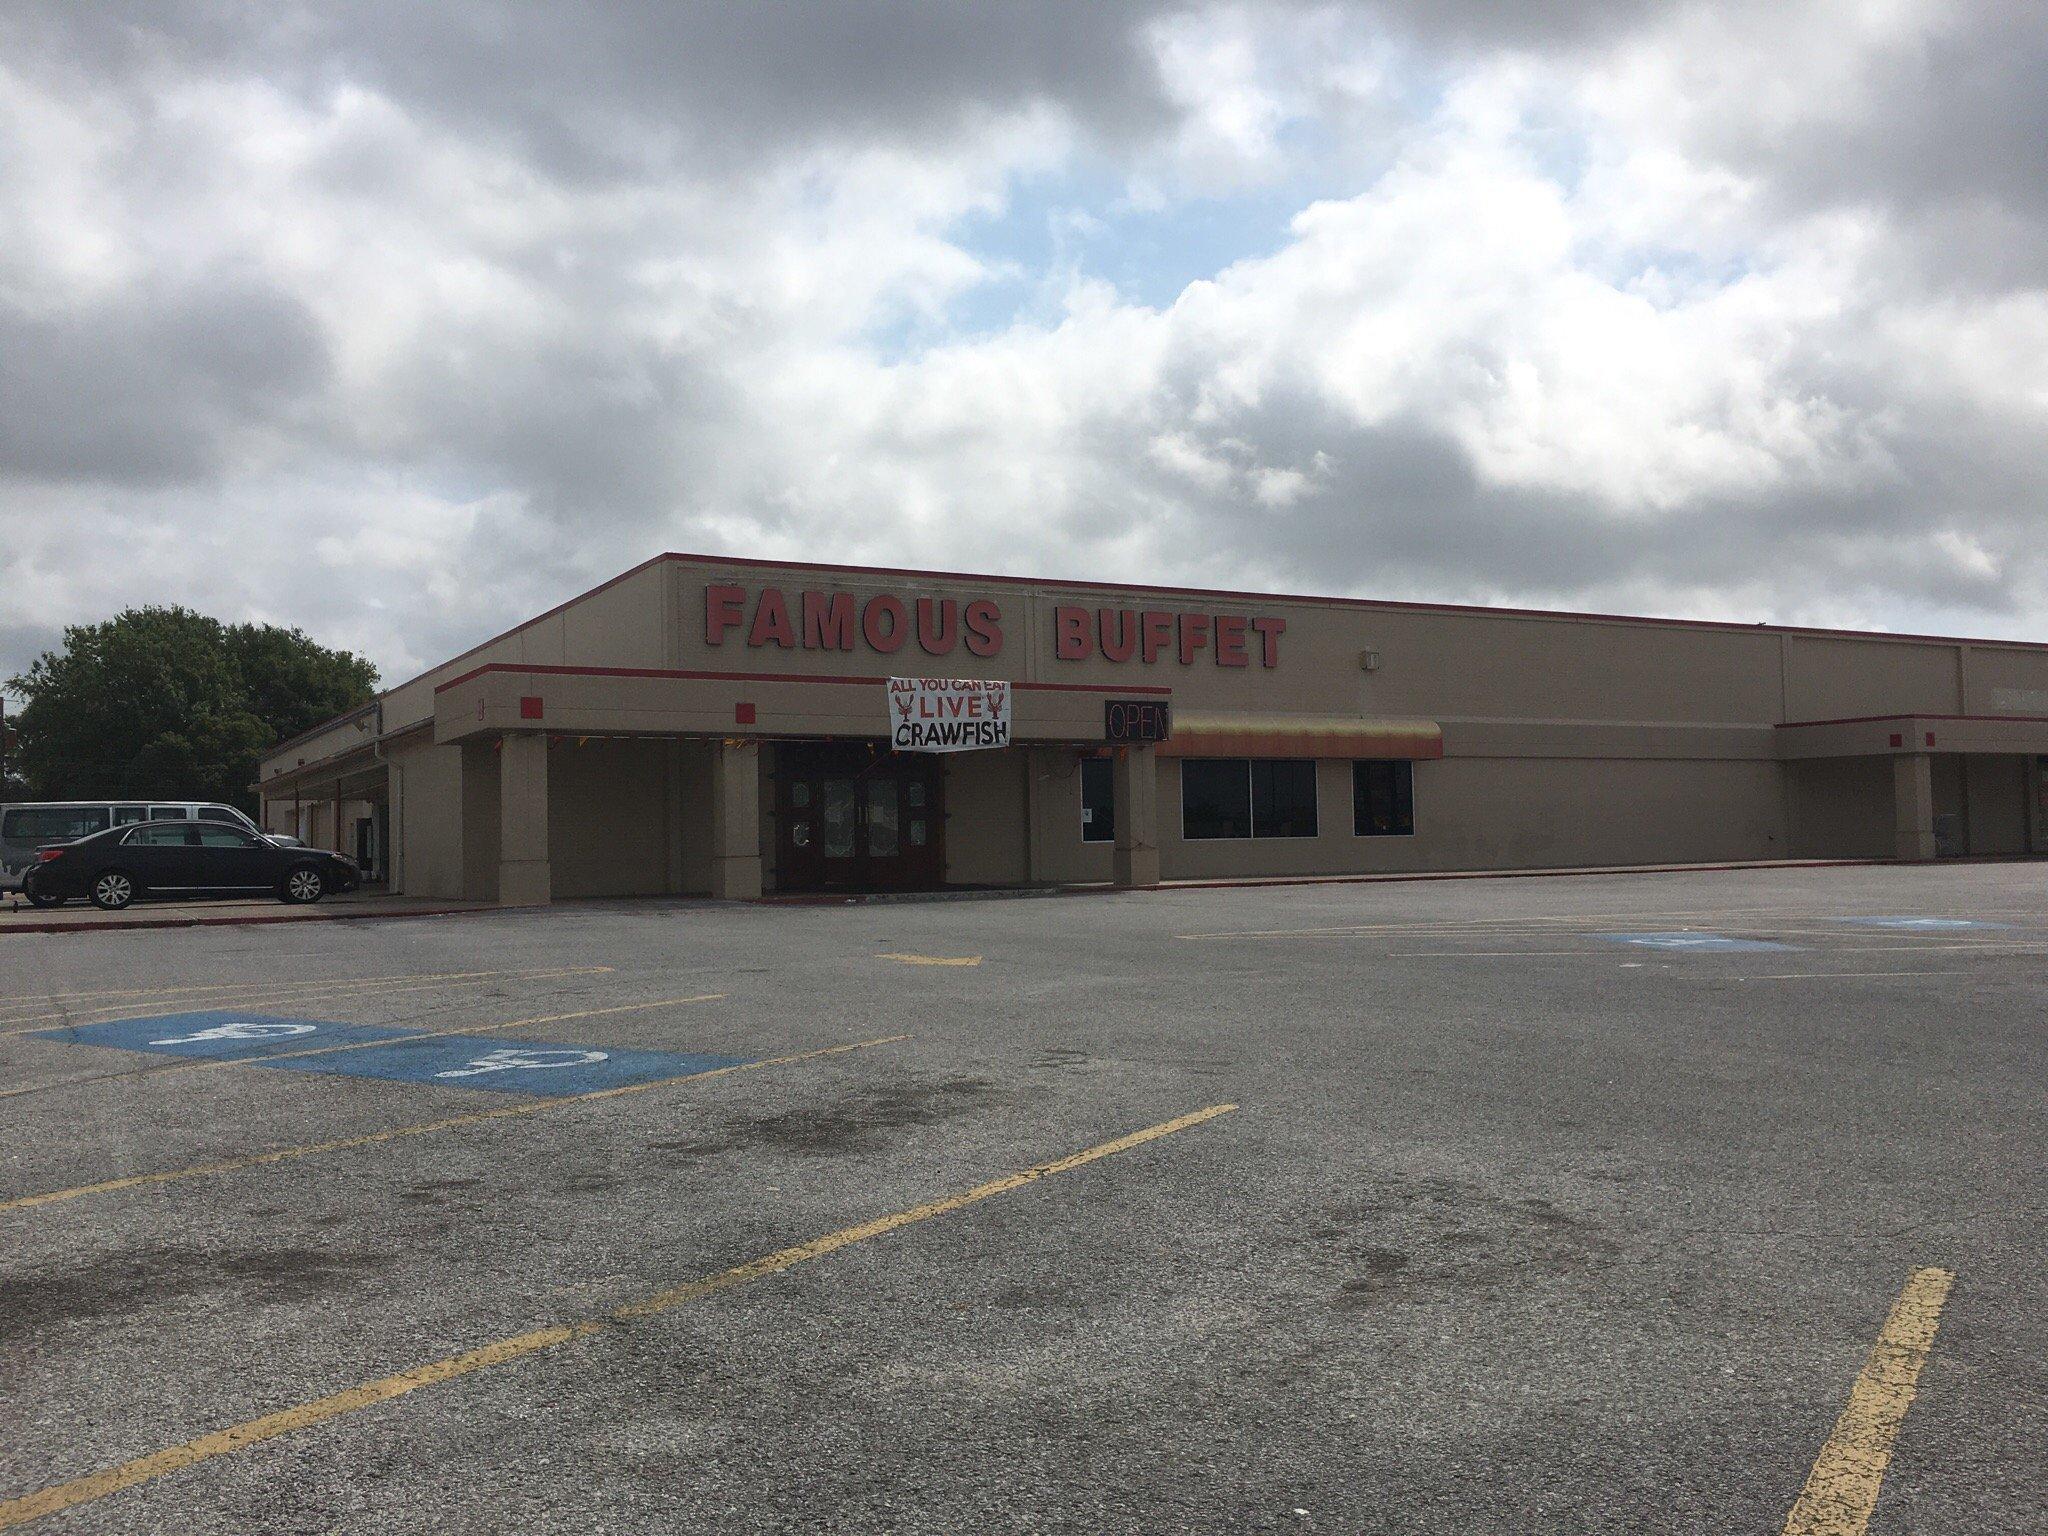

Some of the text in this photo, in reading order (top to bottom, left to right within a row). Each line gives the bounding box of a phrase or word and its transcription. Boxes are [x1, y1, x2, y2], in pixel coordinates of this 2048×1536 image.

[705, 585, 1287, 668] FAMOUS BUFFET
[891, 680, 916, 693] ALL
[919, 680, 949, 691] YOU
[951, 680, 981, 691] CAN
[920, 696, 982, 718] LIVE
[895, 721, 1007, 746] CRAWFISH
[1109, 703, 1169, 741] OPEN
